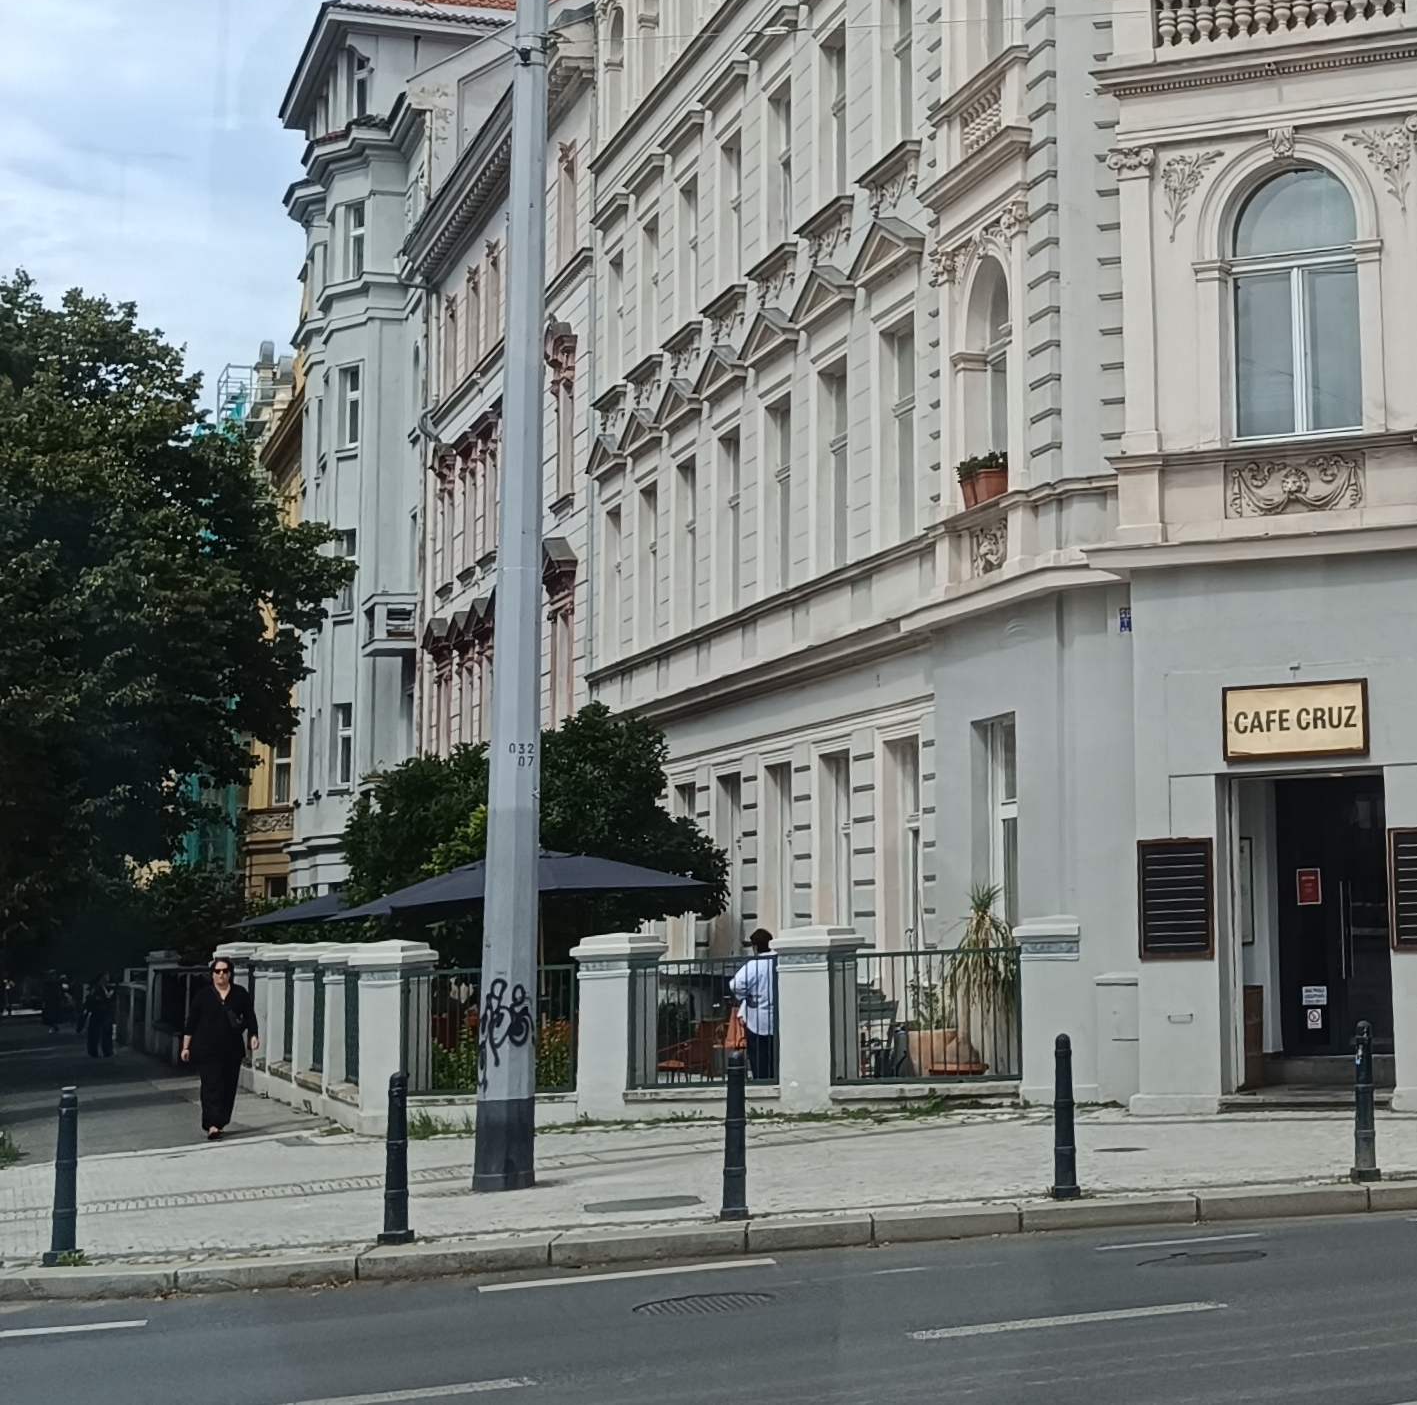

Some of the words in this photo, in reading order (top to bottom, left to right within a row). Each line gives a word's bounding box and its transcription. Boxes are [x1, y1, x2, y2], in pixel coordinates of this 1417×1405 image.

[1234, 709, 1290, 734] CAFE
[1296, 706, 1357, 730] CRUZ
[508, 742, 534, 754] 032
[518, 756, 534, 767] 07
